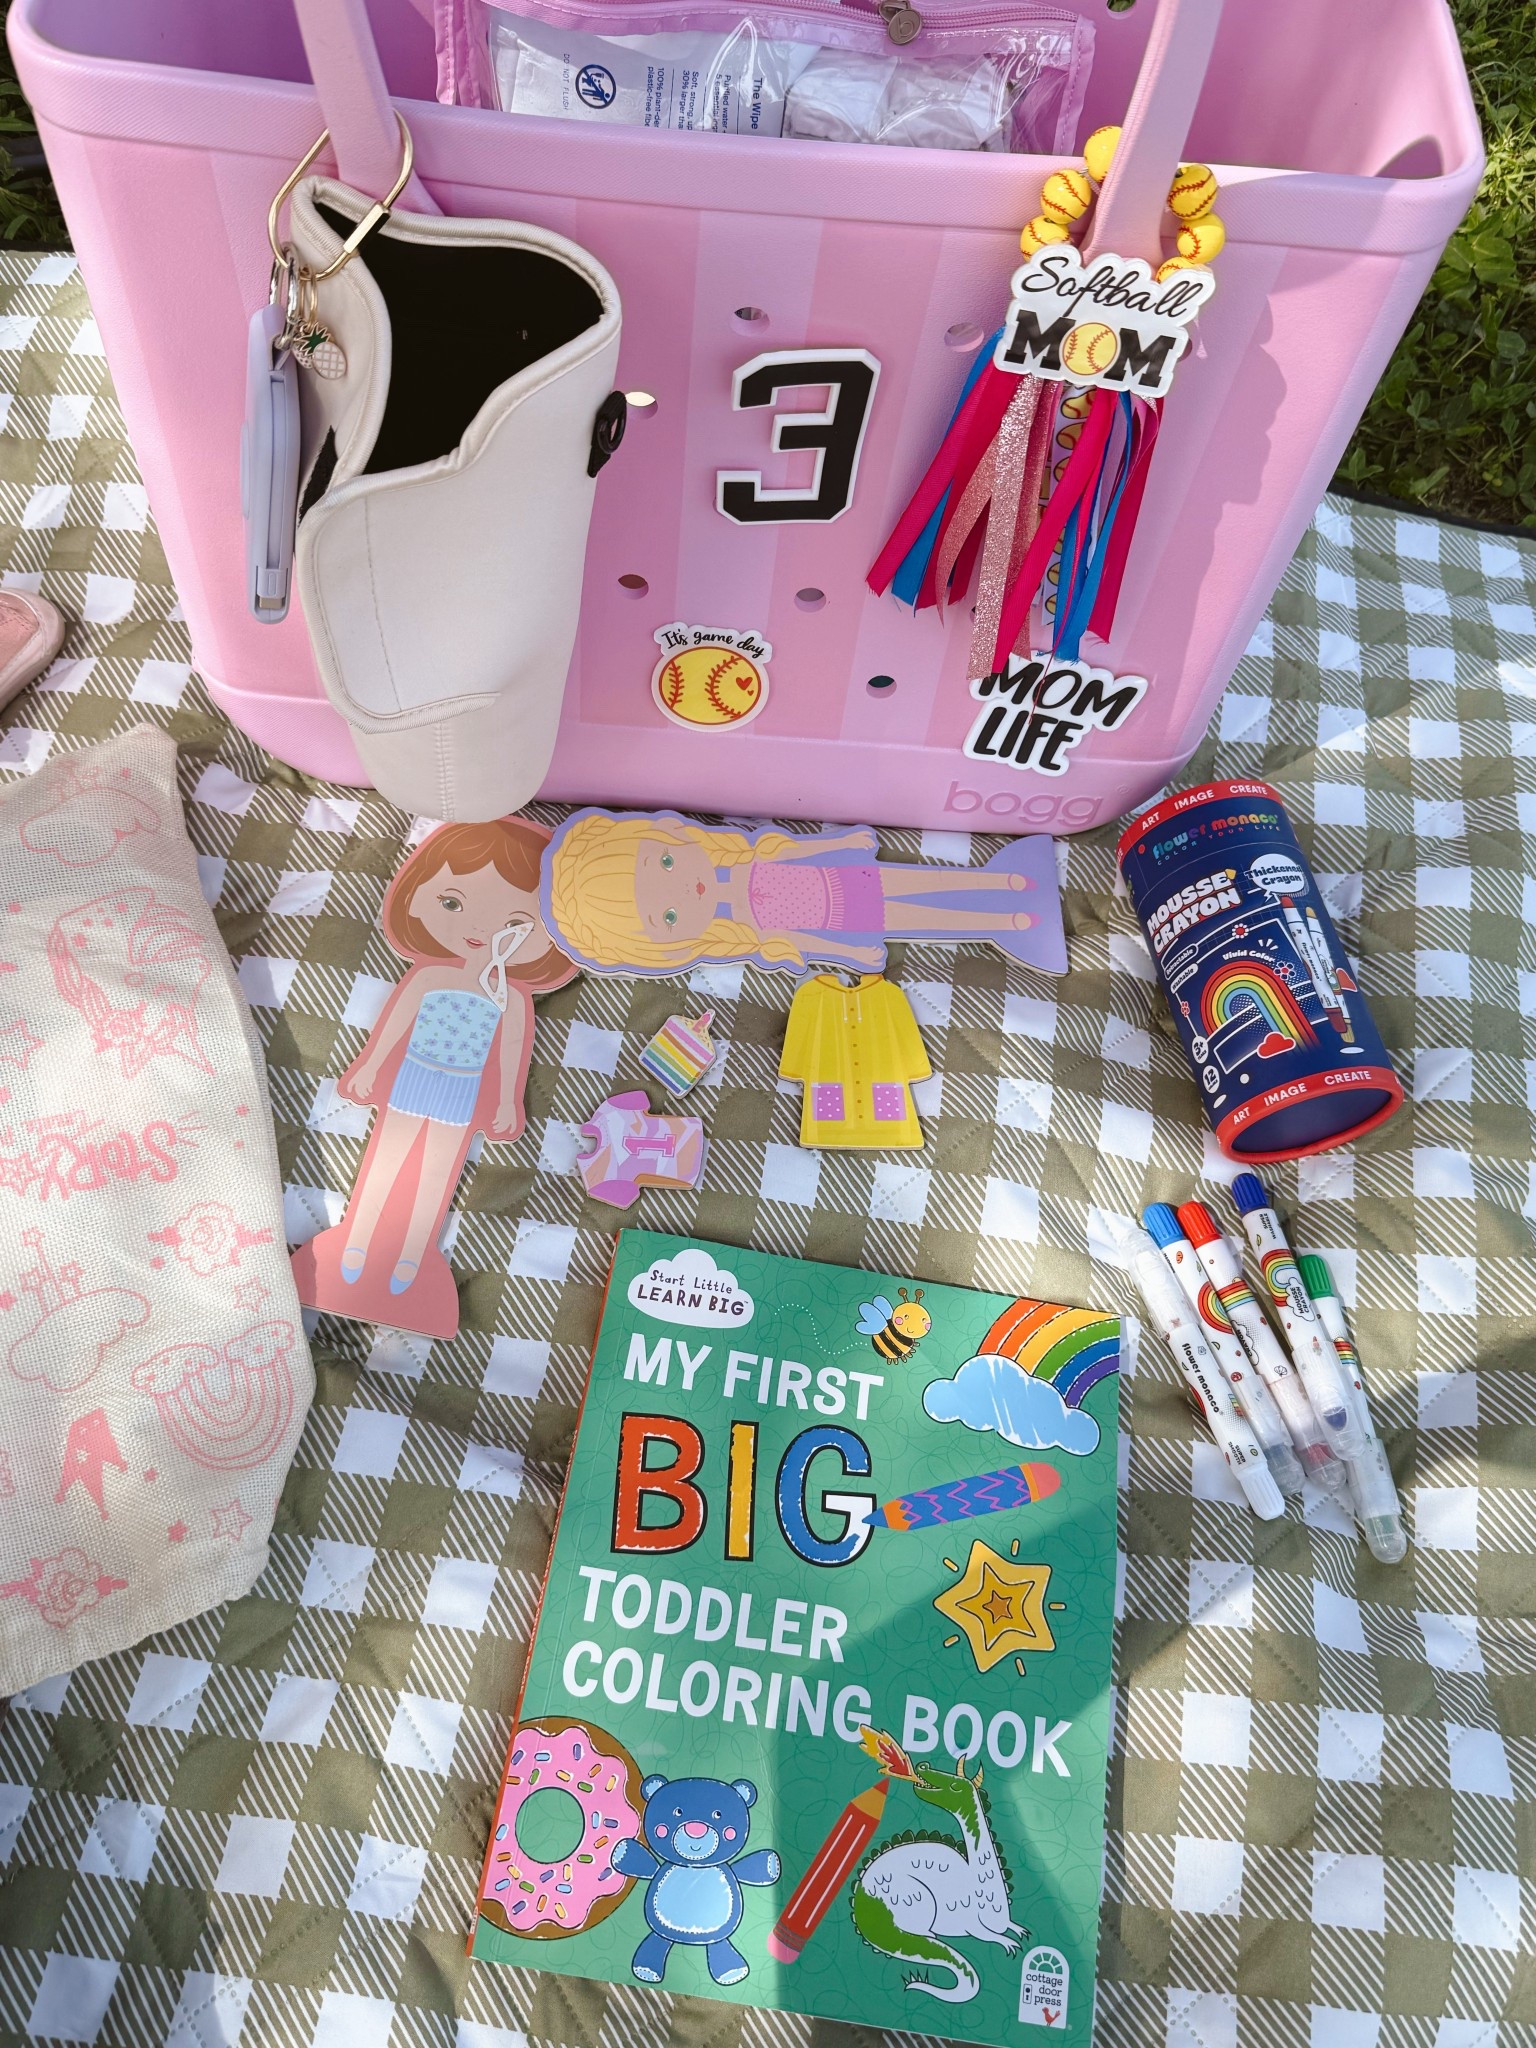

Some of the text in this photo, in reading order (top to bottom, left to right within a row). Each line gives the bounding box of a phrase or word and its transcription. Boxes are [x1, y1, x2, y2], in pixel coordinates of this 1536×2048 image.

[563, 53, 570, 64] DO
[645, 66, 654, 112] plastic-free
[656, 68, 665, 91] 100%
[682, 70, 690, 89] 30%
[691, 72, 699, 90] Soft,
[722, 75, 731, 106] Purified
[562, 87, 570, 110] FLUSH
[679, 90, 688, 115] larger
[687, 92, 696, 120] strong,
[750, 77, 763, 130] The Wipe
[1021, 256, 1203, 318] Softball
[720, 353, 879, 525] 3
[661, 629, 765, 658] It's game day
[978, 659, 1138, 727] MOM
[973, 706, 1083, 771] LIFE
[943, 780, 1104, 828] bogg
[1142, 785, 1268, 831] ART IMAGE CREATE
[1152, 825, 1206, 860] flower
[1211, 813, 1277, 832] monaco
[1261, 875, 1303, 887] Crayon
[1147, 870, 1233, 937] MOUSSE
[1153, 887, 1241, 953] CRAYON
[1222, 949, 1276, 963] Vivid Color
[1204, 1068, 1217, 1086] 12
[1233, 1106, 1251, 1125] ART
[1264, 1083, 1307, 1107] IMAGE
[1324, 1070, 1372, 1086] CREATE
[650, 1269, 733, 1295] Start Little
[637, 1284, 745, 1316] LEARN BIG
[1290, 1287, 1305, 1315] MOUSSE
[1296, 1286, 1310, 1314] CRAYON
[623, 1332, 884, 1421] MY FIRST
[1181, 1342, 1220, 1414] flower monaco
[610, 1411, 877, 1569] BIG
[578, 1565, 849, 1664] TODDLER
[562, 1640, 1073, 1778] COLORING BOOK
[1026, 1973, 1063, 1988] cottage
[1039, 1985, 1062, 1997] door
[1034, 1995, 1062, 2007] press
